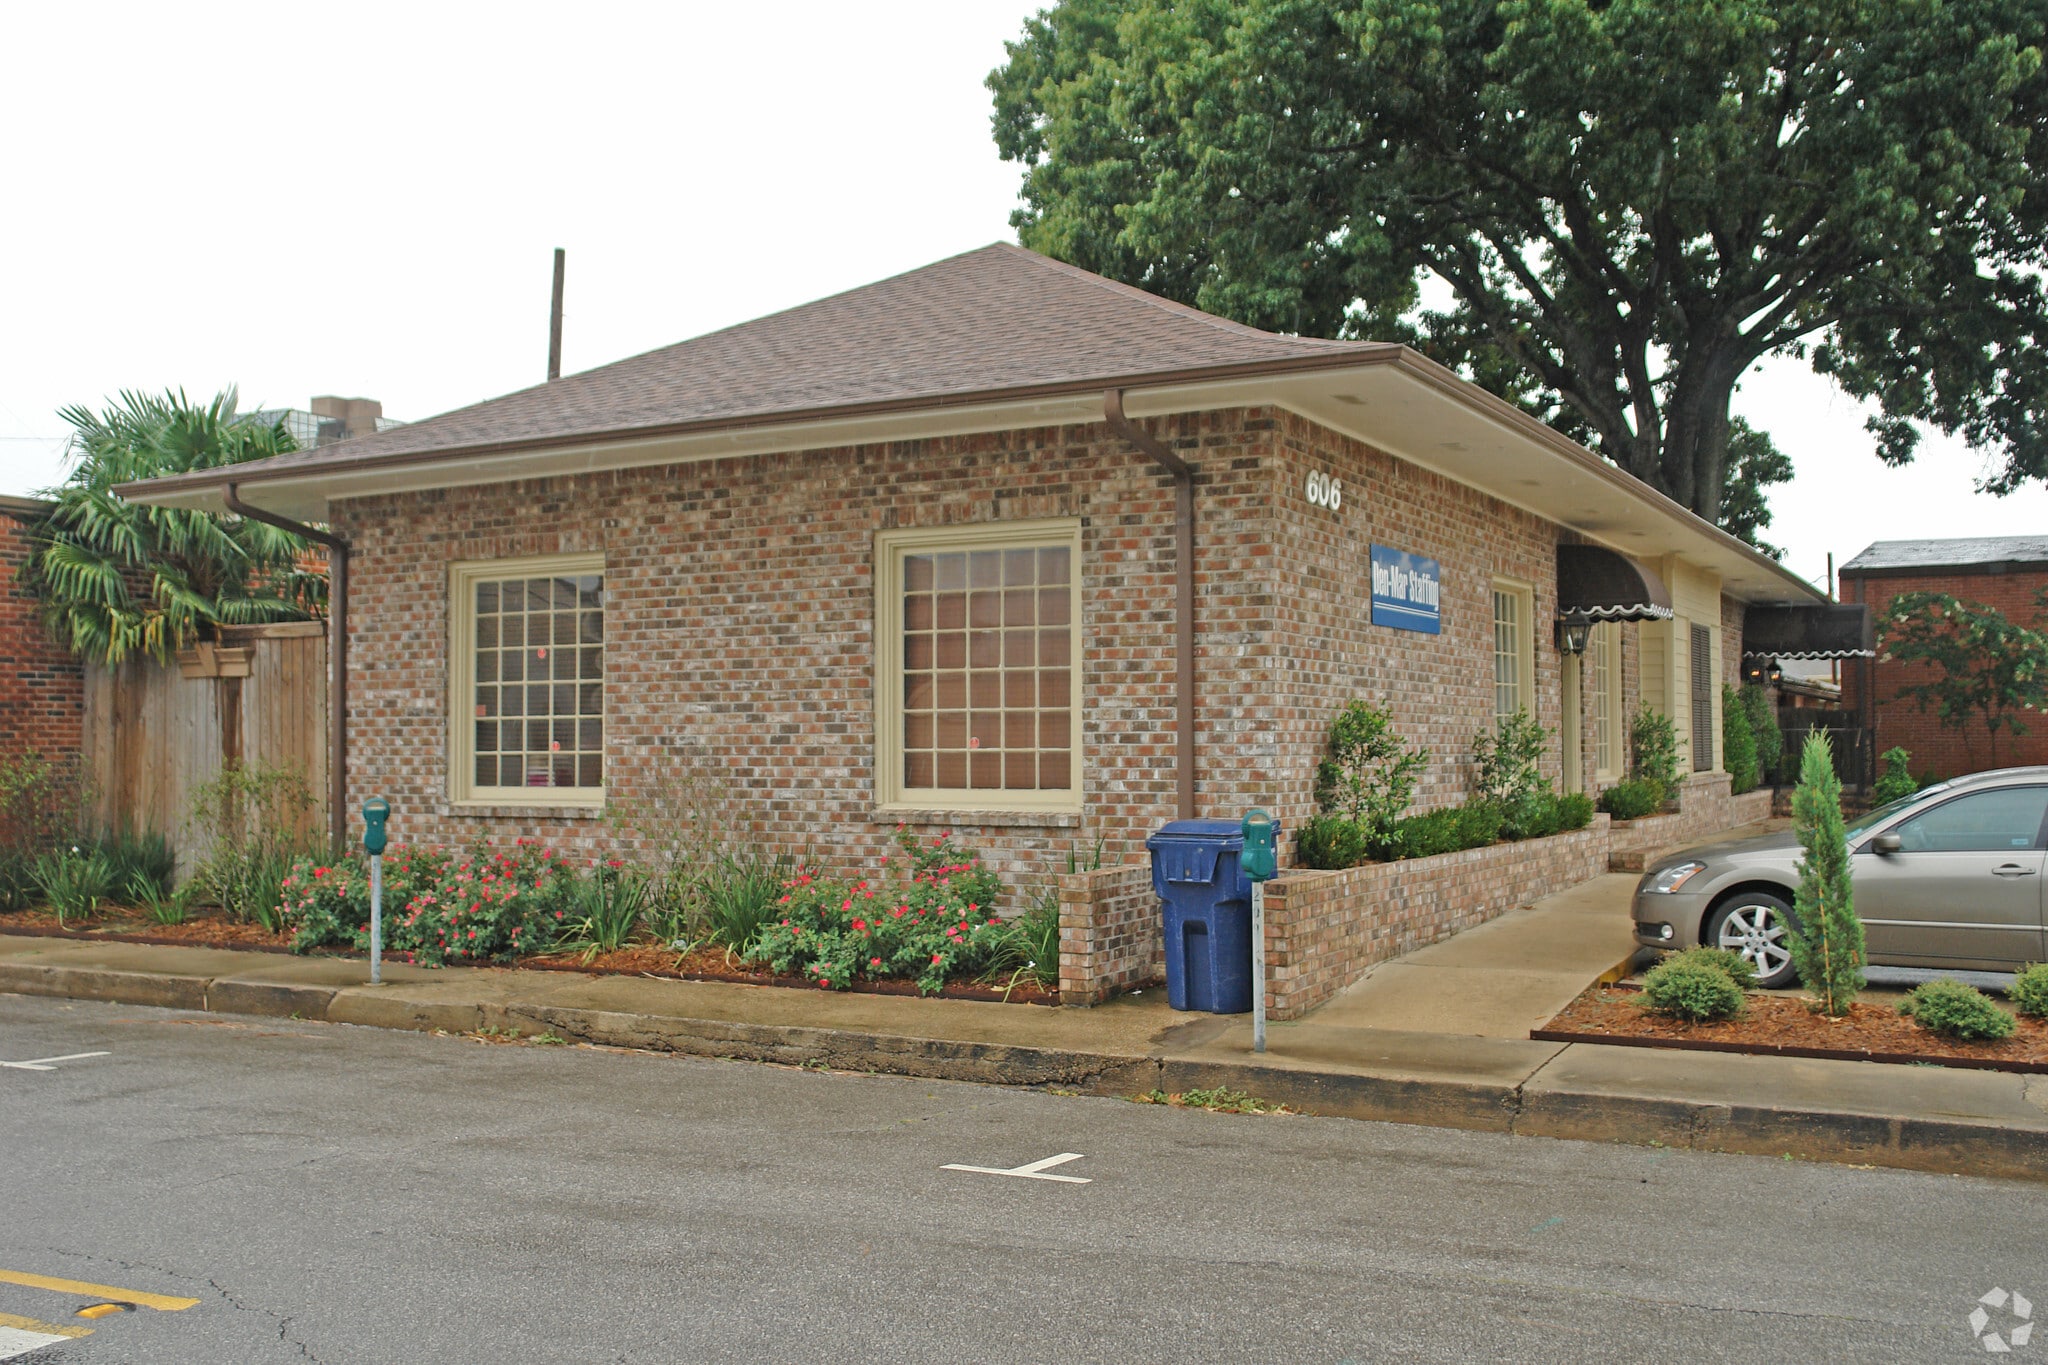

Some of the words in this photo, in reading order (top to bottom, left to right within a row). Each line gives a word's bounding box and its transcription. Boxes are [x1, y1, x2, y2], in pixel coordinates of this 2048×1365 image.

[1305, 470, 1341, 510] 606
[1373, 561, 1408, 600] Den-Mar
[1409, 570, 1439, 611] Staffing
